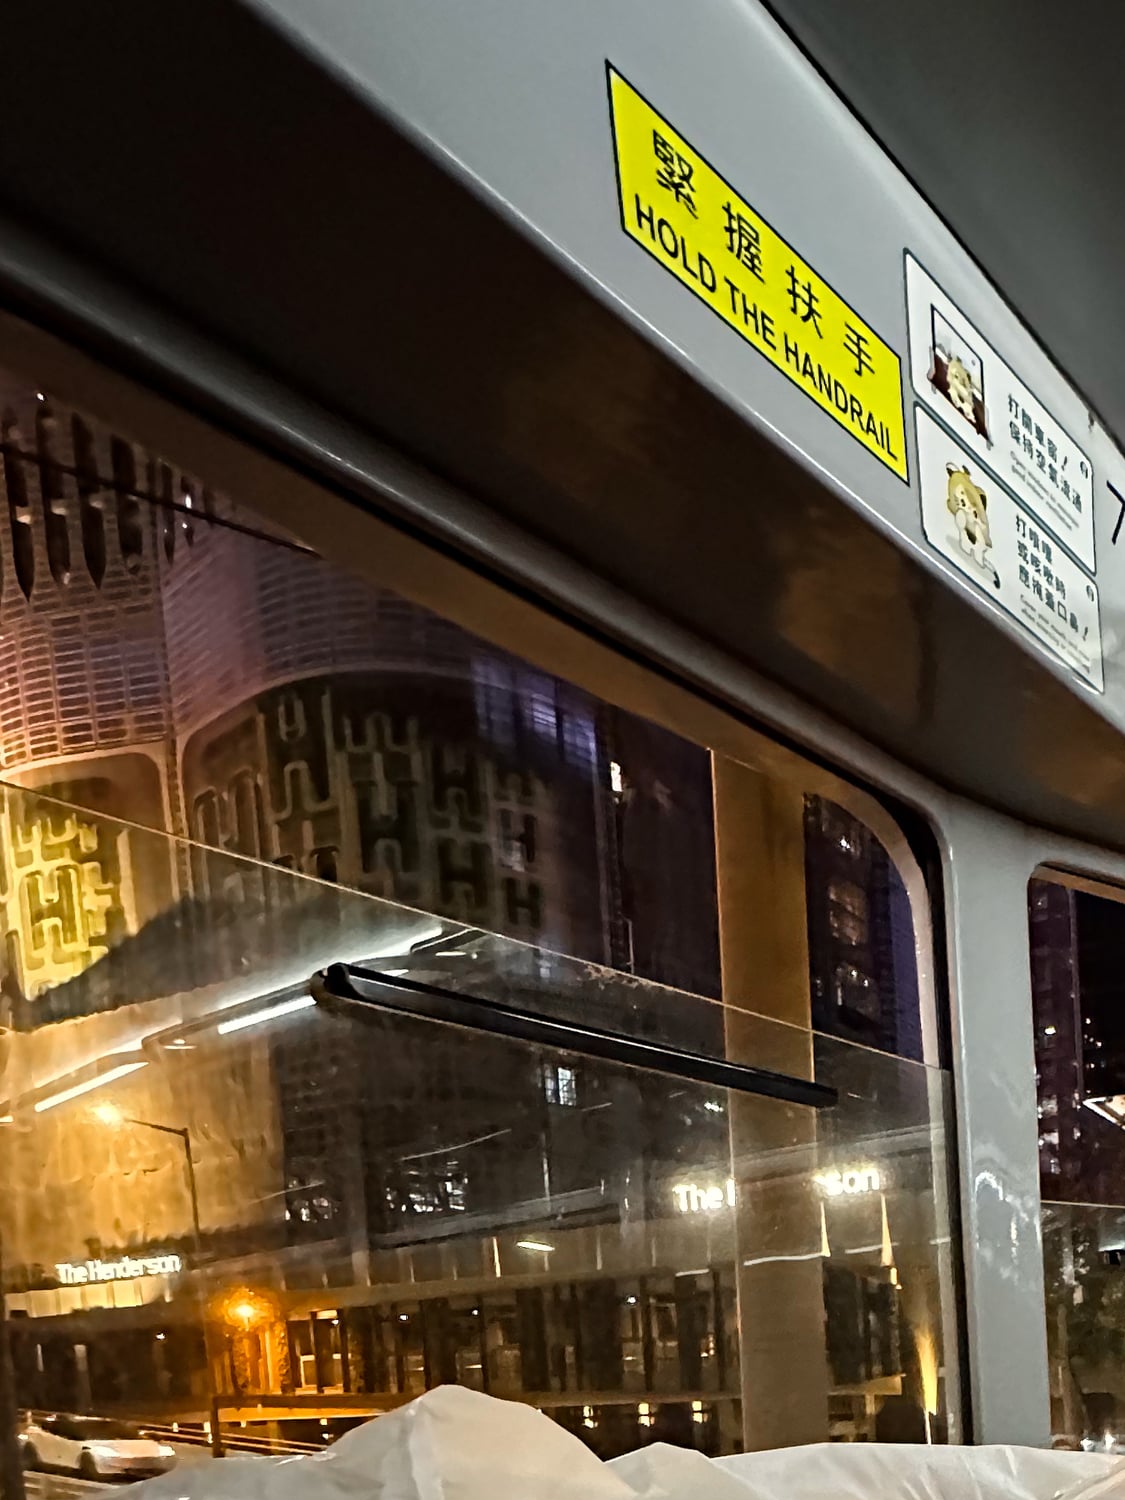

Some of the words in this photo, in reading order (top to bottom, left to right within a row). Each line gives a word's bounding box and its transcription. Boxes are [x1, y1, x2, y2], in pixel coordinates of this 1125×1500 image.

[653, 128, 876, 378] 緊握扶手
[634, 193, 718, 294] HOLD
[723, 275, 778, 352] THE
[783, 331, 899, 462] HANDRAIL
[672, 1182, 725, 1213] The
[55, 1263, 88, 1285] The
[86, 1255, 181, 1280] Henderson
